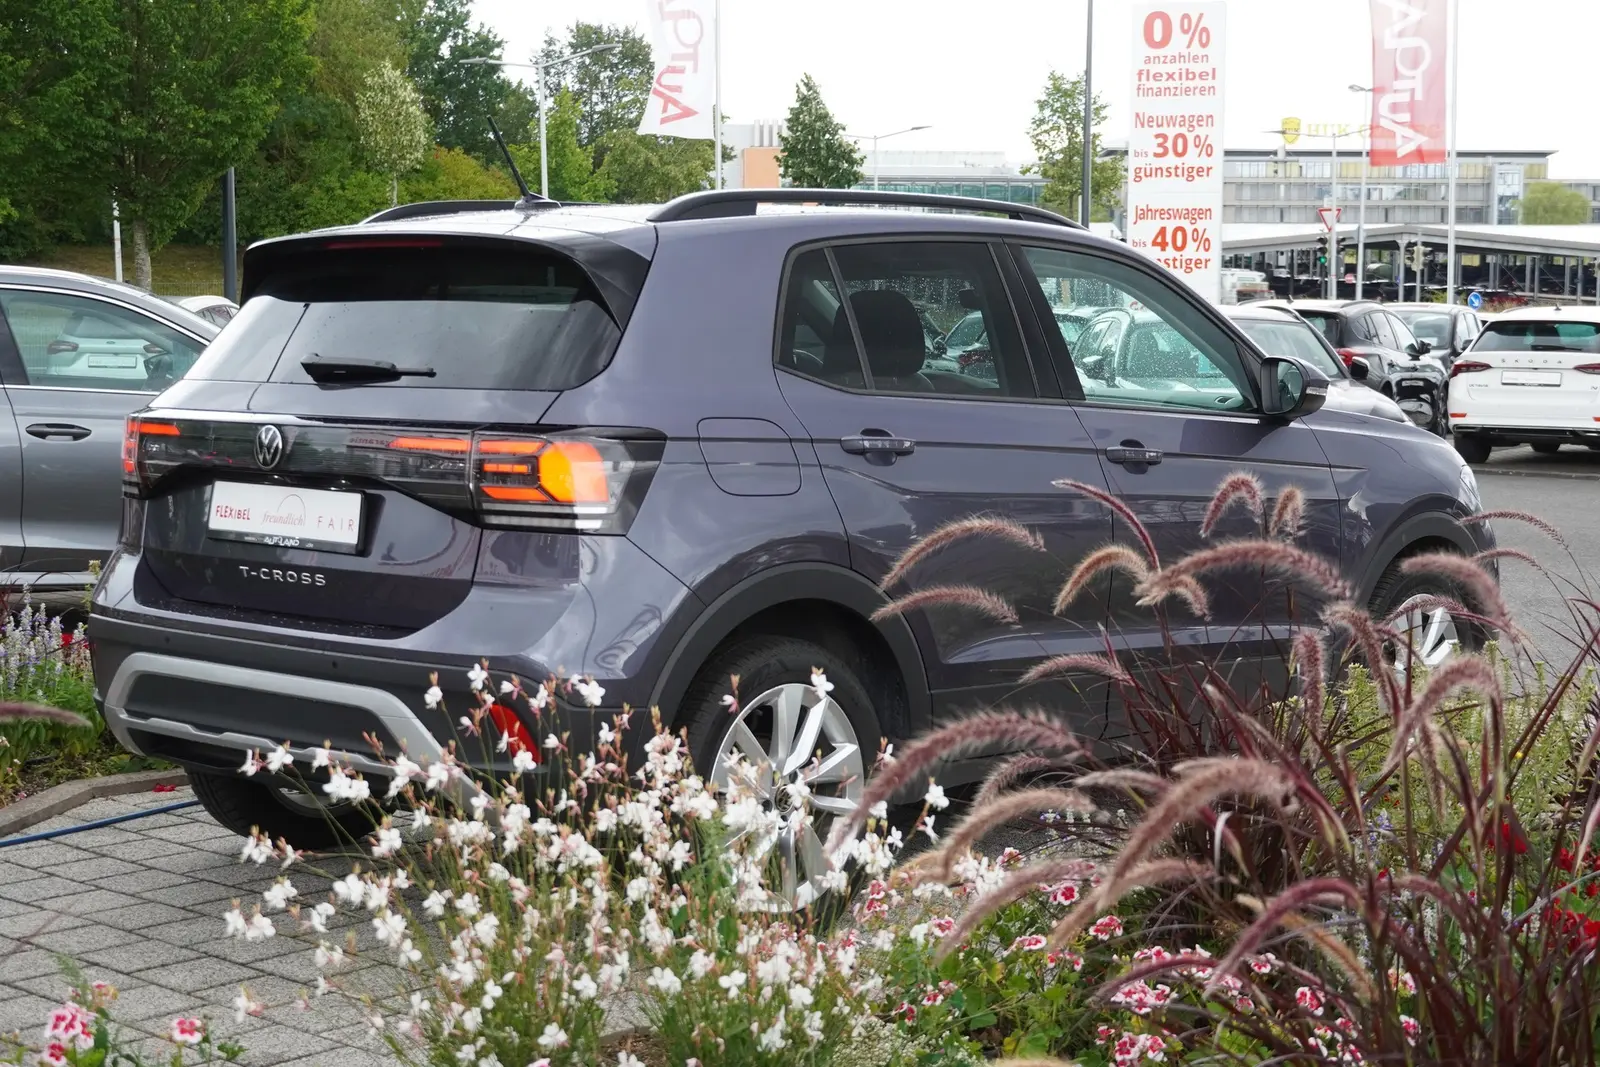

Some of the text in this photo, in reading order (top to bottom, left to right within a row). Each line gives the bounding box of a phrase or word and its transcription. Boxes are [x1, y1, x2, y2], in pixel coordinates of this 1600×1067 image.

[1144, 52, 1209, 65] anzahlen
[1136, 67, 1216, 82] flexibel
[1136, 83, 1216, 97] finanzieren
[1134, 112, 1214, 133] Neuwagen
[1134, 149, 1149, 158] bis
[1133, 162, 1213, 182] günstiger
[1133, 204, 1212, 224] Jahreswagen
[1132, 239, 1147, 248] bis
[1156, 254, 1211, 273] stiger
[215, 505, 355, 532] FLEXIBEL freundlich FAIR
[239, 565, 326, 586] T-CROSS
